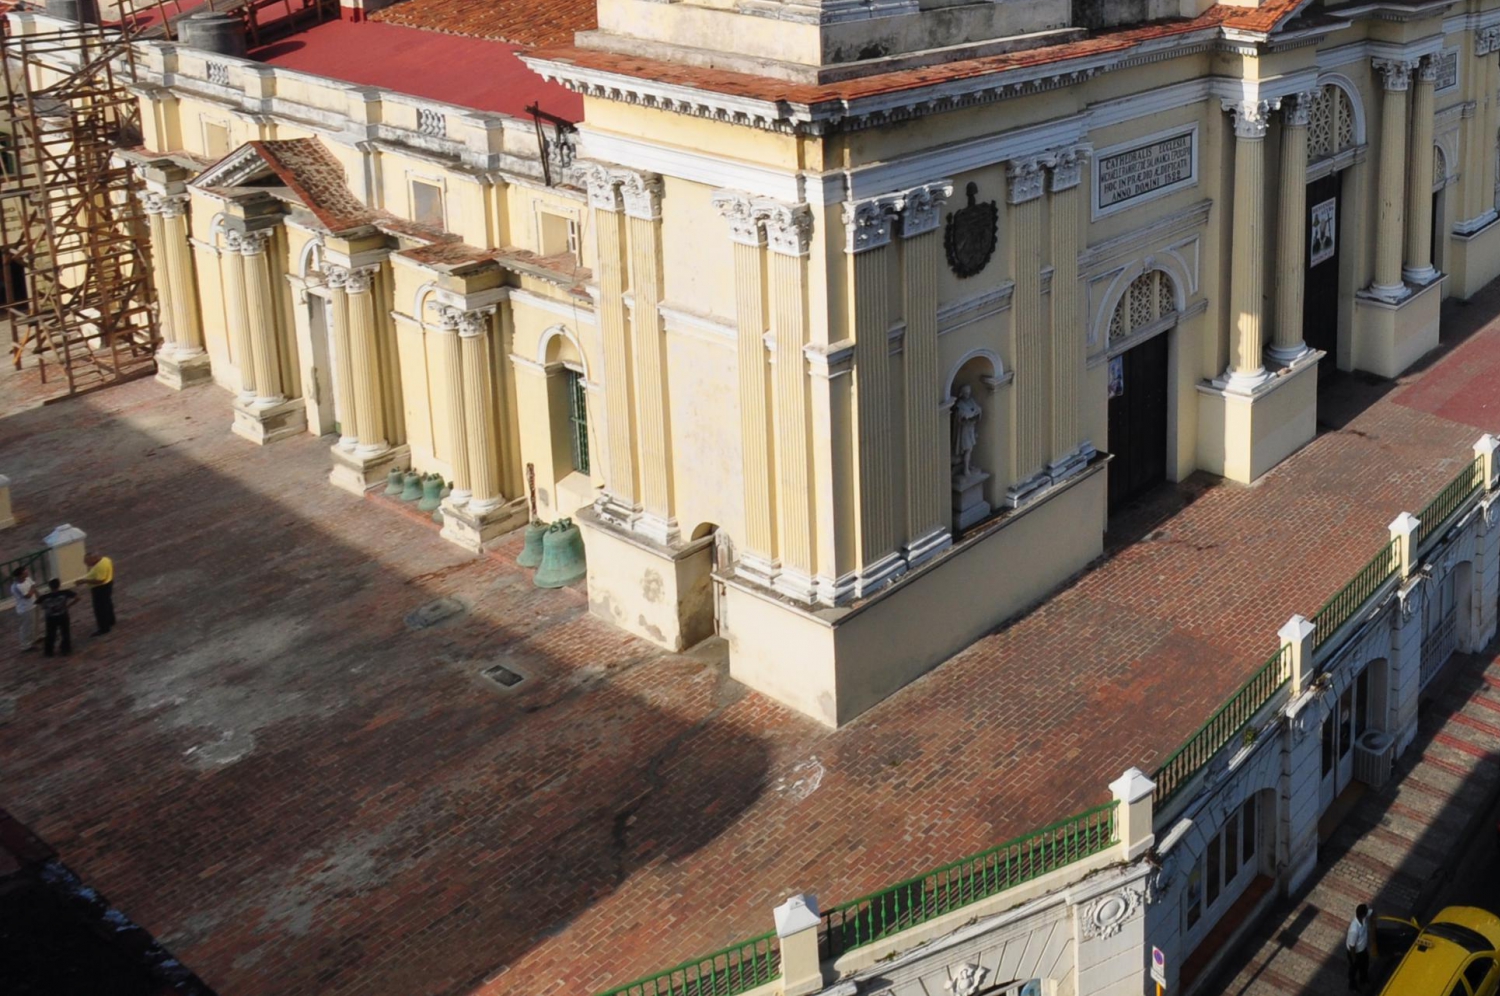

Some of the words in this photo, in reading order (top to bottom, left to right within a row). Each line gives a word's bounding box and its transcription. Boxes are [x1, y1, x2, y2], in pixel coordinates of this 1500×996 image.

[1105, 147, 1152, 170] CATHEDRALIS
[1104, 180, 1117, 194] HOC
[1112, 186, 1132, 202] ANNO
[1135, 177, 1160, 194] DOMINI
[1164, 170, 1181, 183] 1522
